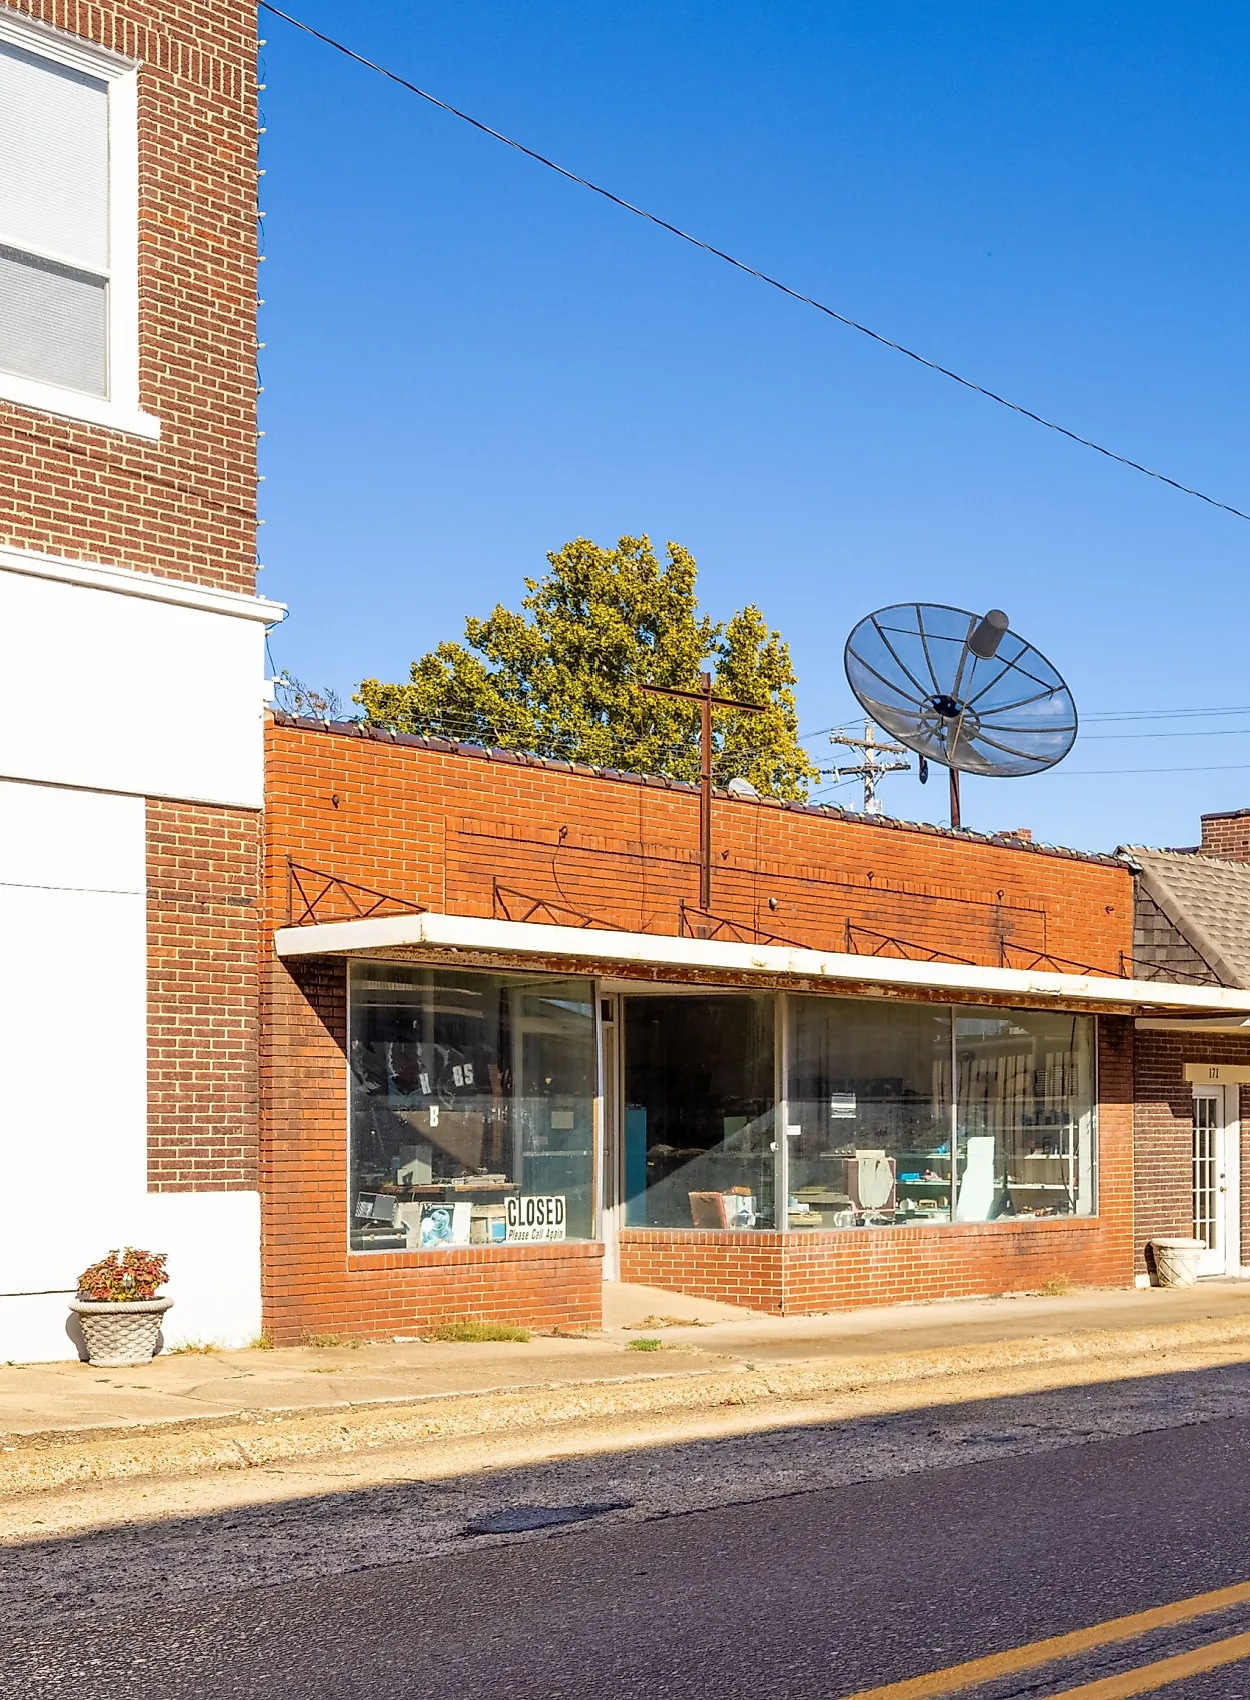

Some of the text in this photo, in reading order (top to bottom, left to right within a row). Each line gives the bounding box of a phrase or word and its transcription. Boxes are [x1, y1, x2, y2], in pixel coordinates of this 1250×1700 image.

[1209, 1068, 1219, 1078] 171
[508, 1198, 563, 1227] CLOSED
[508, 1228, 563, 1241] Please Call Again
